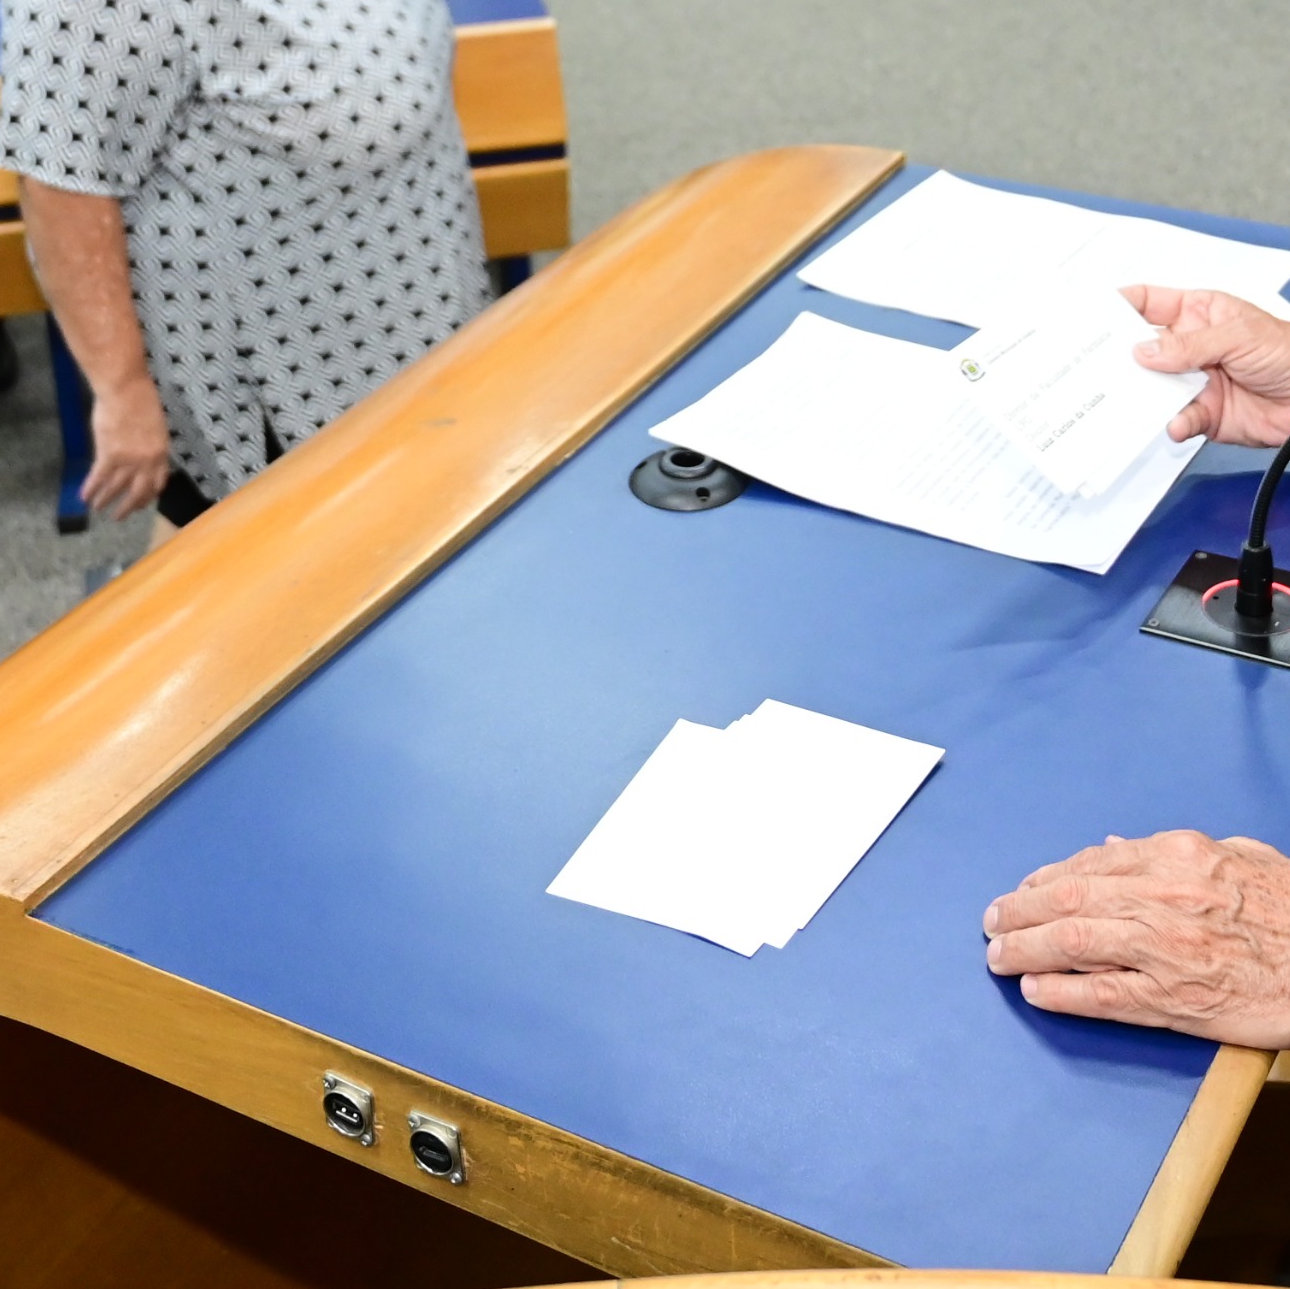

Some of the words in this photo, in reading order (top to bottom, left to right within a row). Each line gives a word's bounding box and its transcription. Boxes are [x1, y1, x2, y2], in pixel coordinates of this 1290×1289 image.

[1052, 418, 1076, 438] Carlos
[1075, 410, 1085, 419] da
[1083, 393, 1106, 411] Cunha
